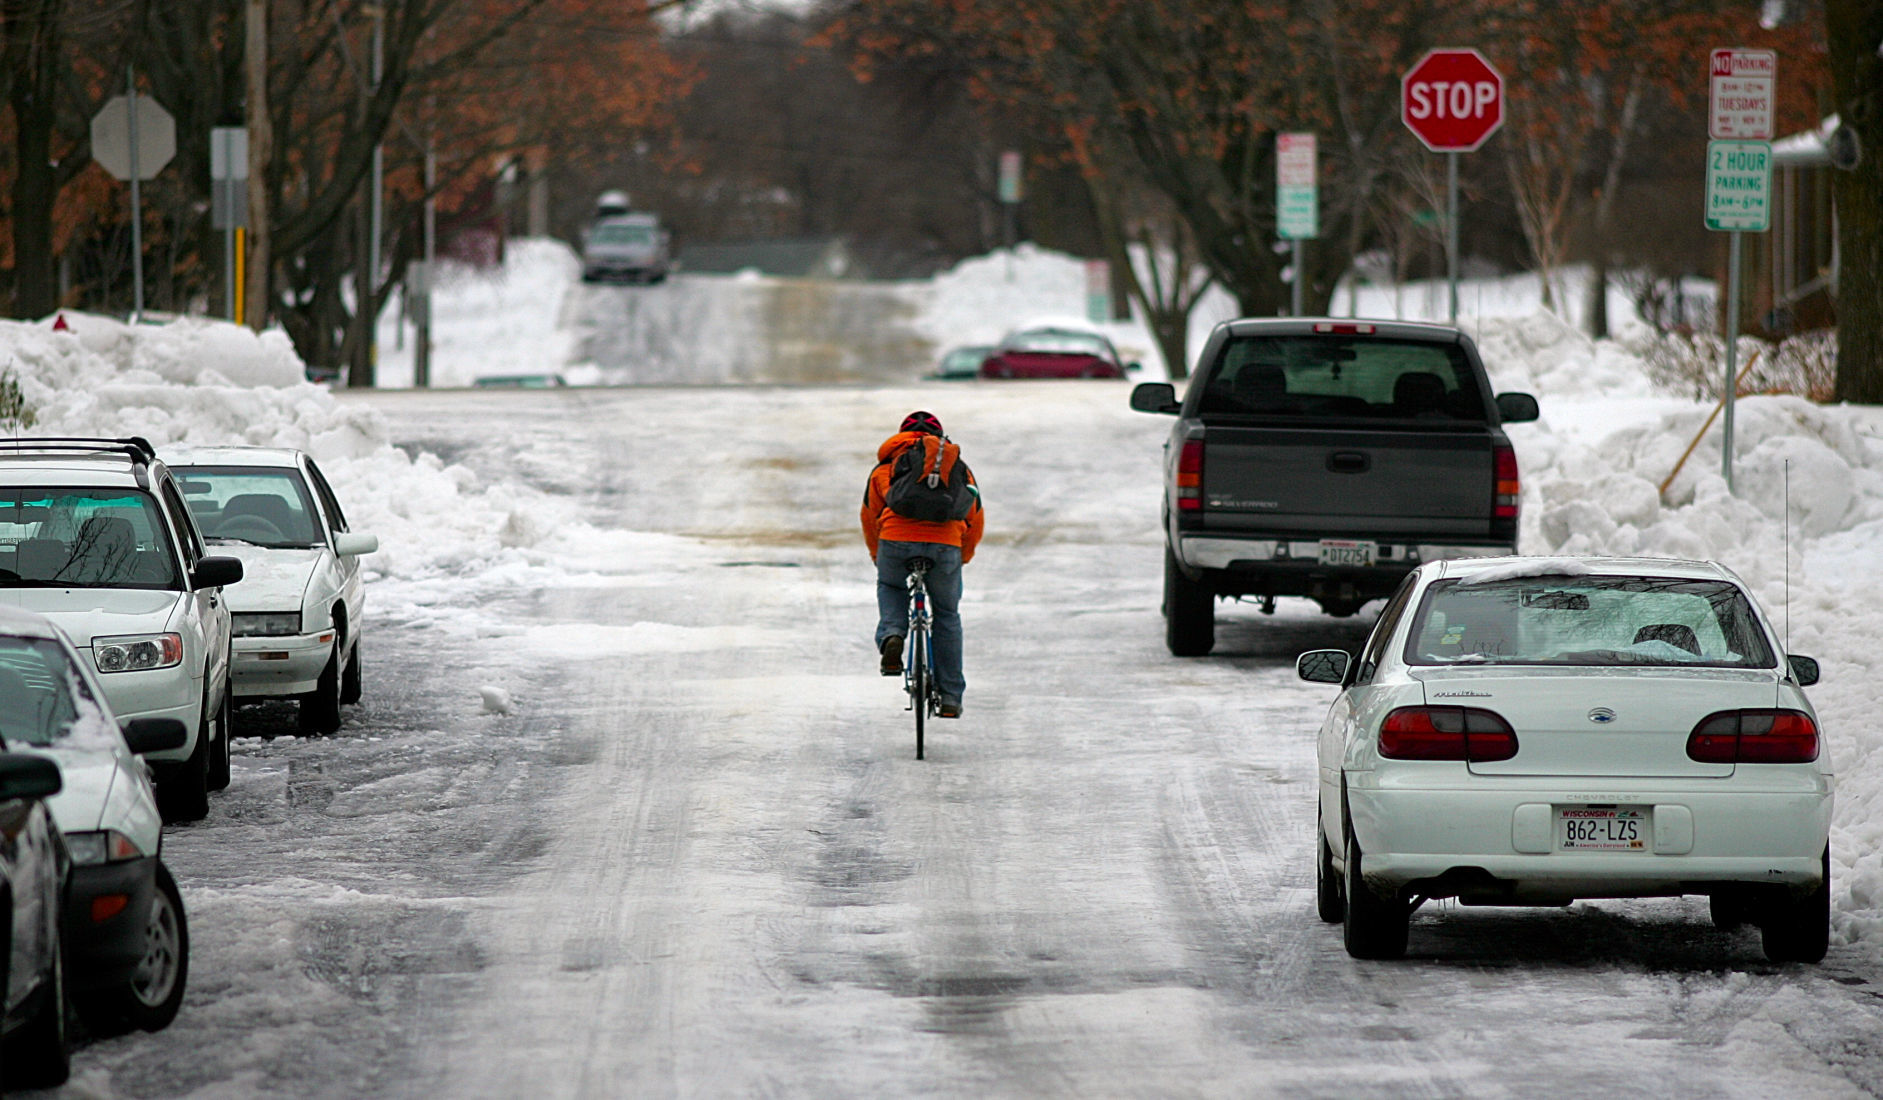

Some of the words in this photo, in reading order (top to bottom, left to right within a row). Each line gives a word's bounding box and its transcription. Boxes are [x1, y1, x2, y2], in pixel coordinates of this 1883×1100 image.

[1713, 56, 1730, 74] NO
[1732, 58, 1770, 71] PARKING
[1410, 81, 1497, 119] STOP
[1718, 96, 1767, 112] TUESDAYS
[1713, 152, 1722, 170] 2
[1727, 152, 1766, 171] HOUR
[1715, 176, 1762, 191] PARKING
[1562, 810, 1608, 818] WISCONSIN
[1567, 820, 1637, 841] 862-LZS
